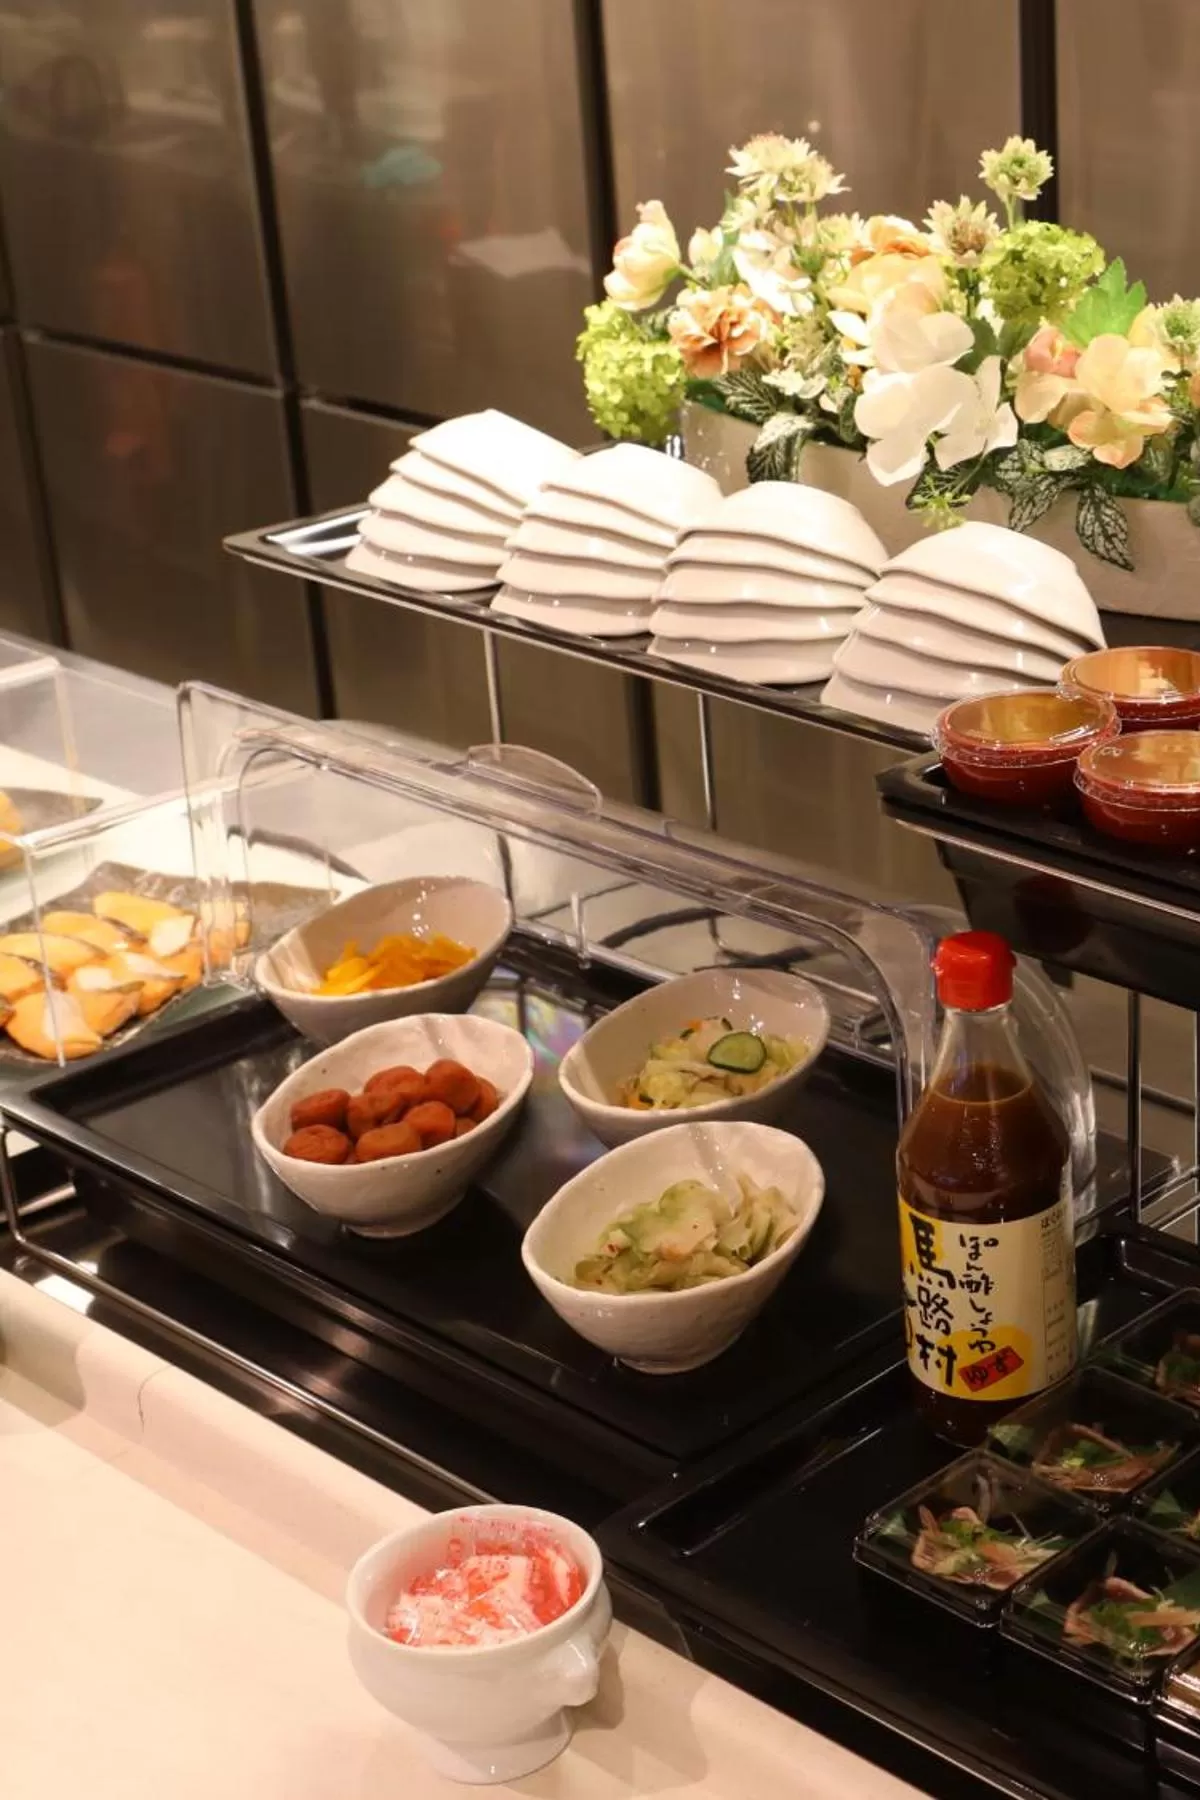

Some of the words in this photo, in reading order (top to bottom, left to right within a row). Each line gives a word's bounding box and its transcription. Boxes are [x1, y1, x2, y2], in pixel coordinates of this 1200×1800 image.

[907, 1211, 958, 1388] 馬路村
[957, 1233, 1000, 1355] ぽん酢しょうゆ
[965, 1351, 1012, 1386] ゆず
